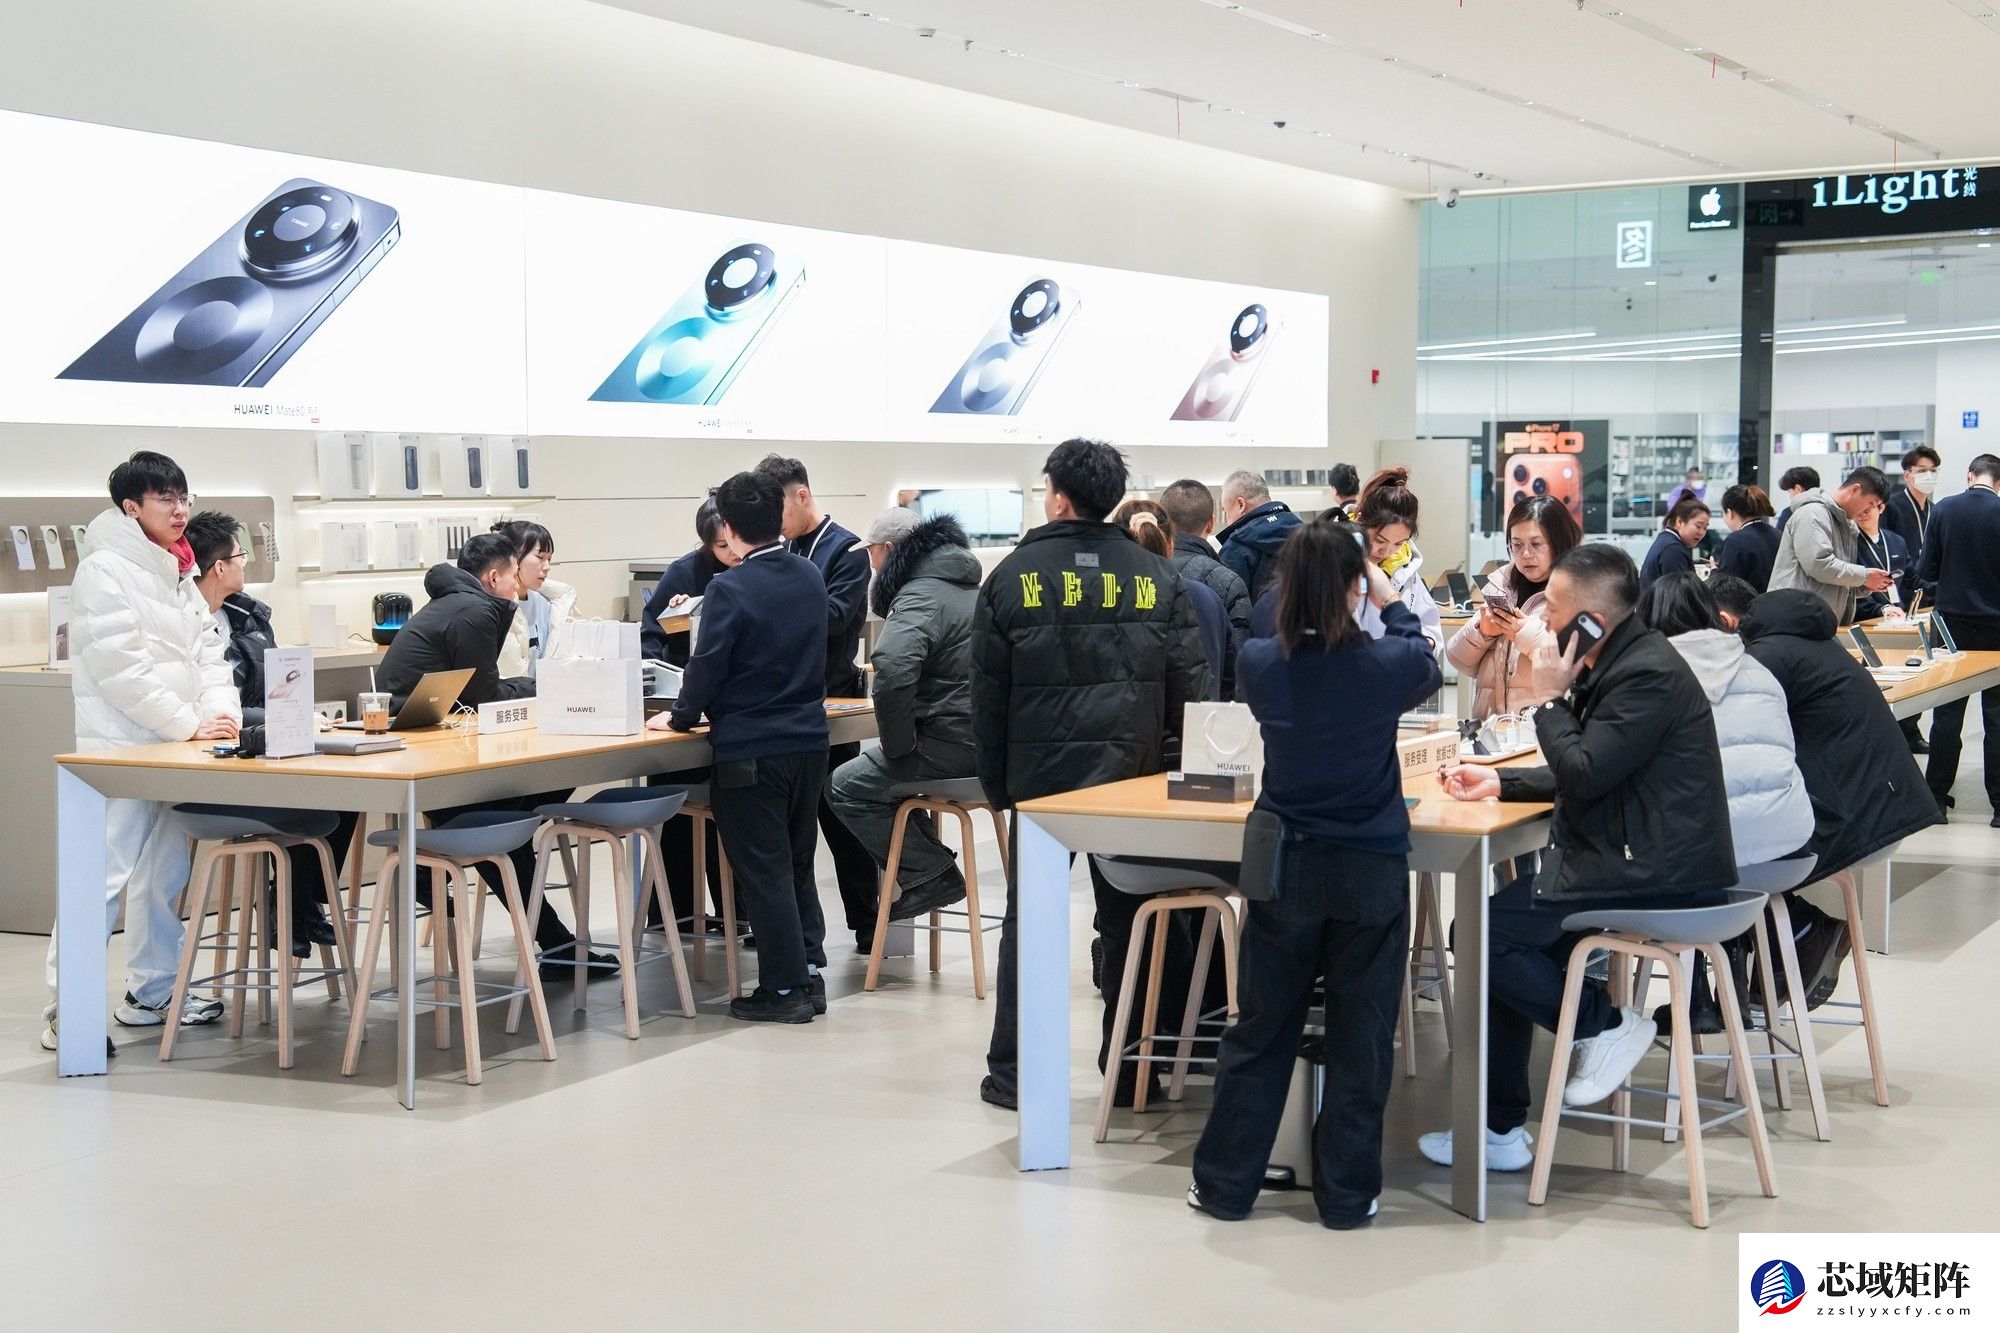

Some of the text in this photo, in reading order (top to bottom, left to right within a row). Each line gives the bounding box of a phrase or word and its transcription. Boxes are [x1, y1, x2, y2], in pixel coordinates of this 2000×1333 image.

[1812, 168, 1960, 214] iLight
[233, 404, 273, 415] HUAWEI
[1504, 431, 1584, 454] PRO
[496, 707, 528, 724] 服务受理
[1216, 762, 1251, 772] HUAWEI
